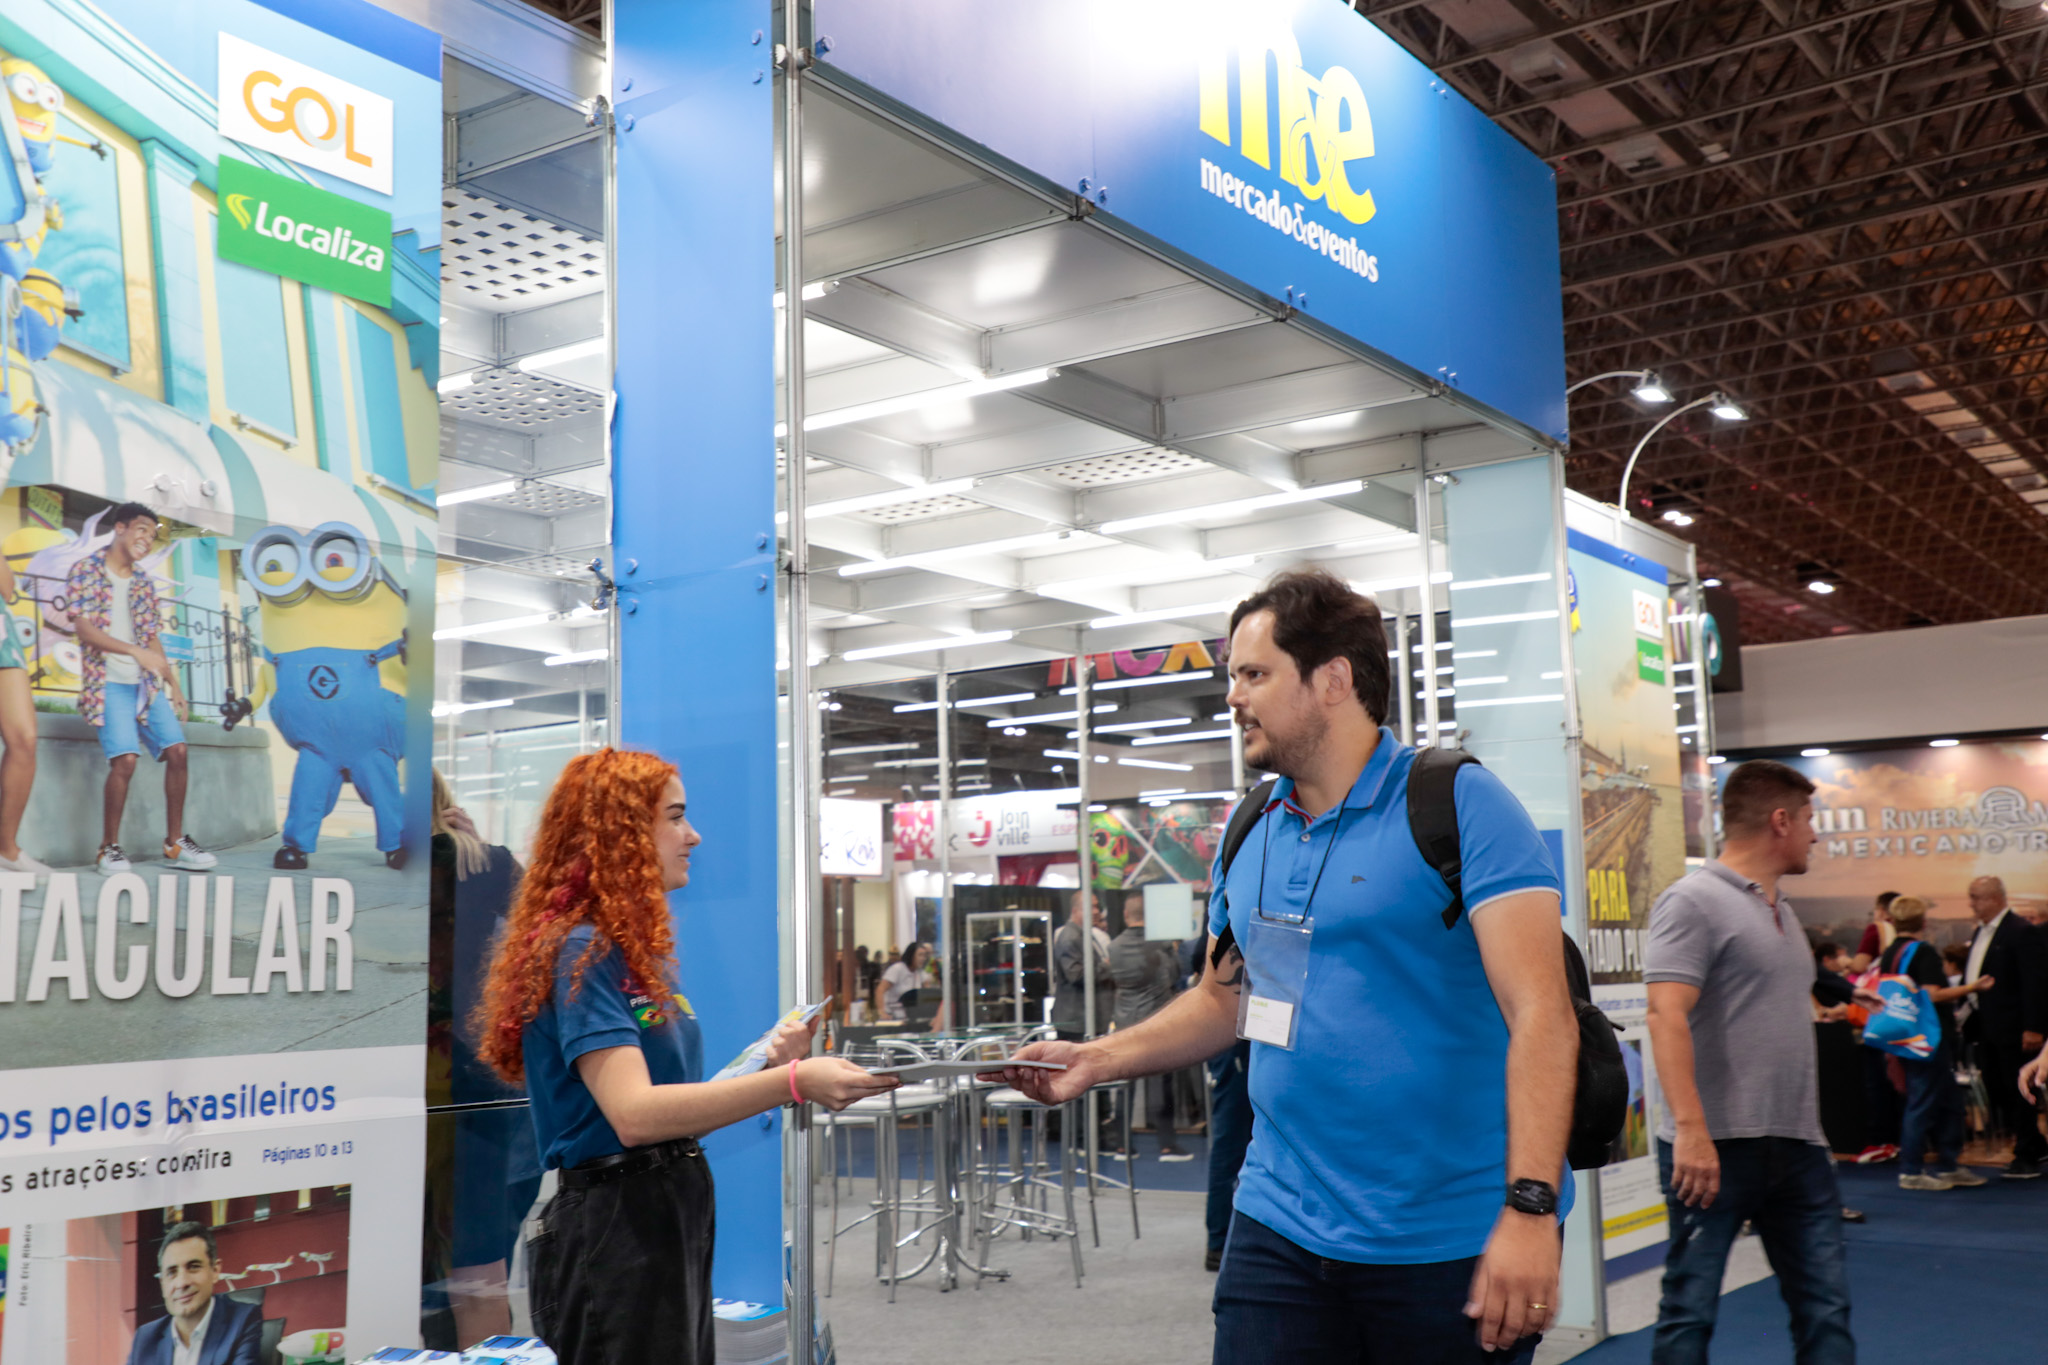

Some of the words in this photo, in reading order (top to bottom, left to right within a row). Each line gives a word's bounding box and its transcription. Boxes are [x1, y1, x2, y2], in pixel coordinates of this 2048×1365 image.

[243, 70, 372, 168] GOL
[255, 201, 385, 272] Localiza
[1201, 157, 1379, 283] mercado&eventos
[1828, 834, 2005, 858] MEXICANO
[1588, 856, 1631, 921] PARÁ
[0, 872, 354, 1002] TACULAR
[50, 1095, 152, 1147] pelos
[167, 1080, 336, 1126] brasileiros
[25, 1158, 147, 1190] atrações:
[262, 1145, 311, 1164] Páginas
[314, 1143, 328, 1157] 10
[330, 1145, 338, 1155] a
[341, 1140, 354, 1154] 13
